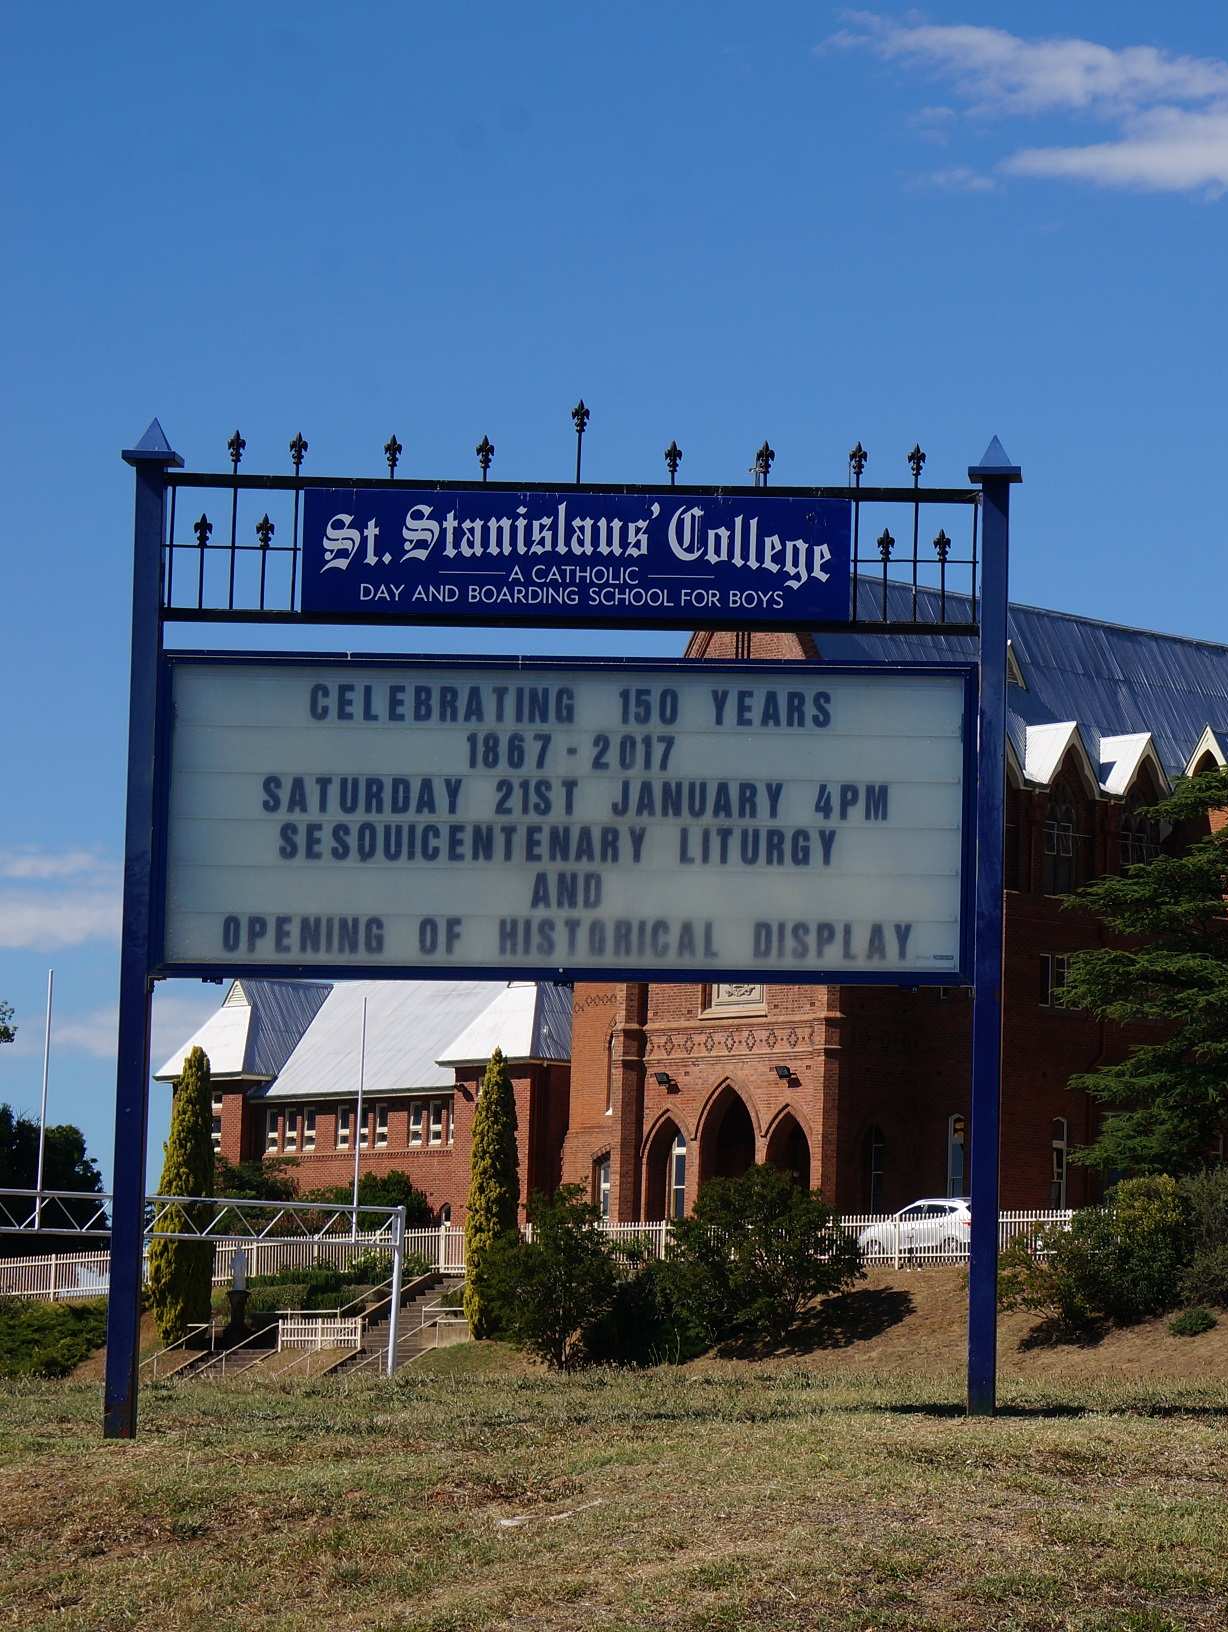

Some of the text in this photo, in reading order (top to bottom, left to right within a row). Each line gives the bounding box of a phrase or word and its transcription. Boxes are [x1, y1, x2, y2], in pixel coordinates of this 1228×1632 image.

[320, 513, 392, 573] St.
[667, 505, 832, 591] College
[360, 583, 784, 609] DAY AND BOARDING SCHOOL FOR BOYS
[508, 565, 639, 585] A CATHOLIC
[309, 682, 832, 729] CELEBRATING 150 YEARS
[262, 775, 889, 821] SATURDAY 21ST JANUARY 4PM
[278, 822, 837, 867] SESQUICENTENARY LITURGY
[530, 871, 602, 910] AND
[221, 915, 913, 961] OPENING OF HISTORICAL DISPLAY
